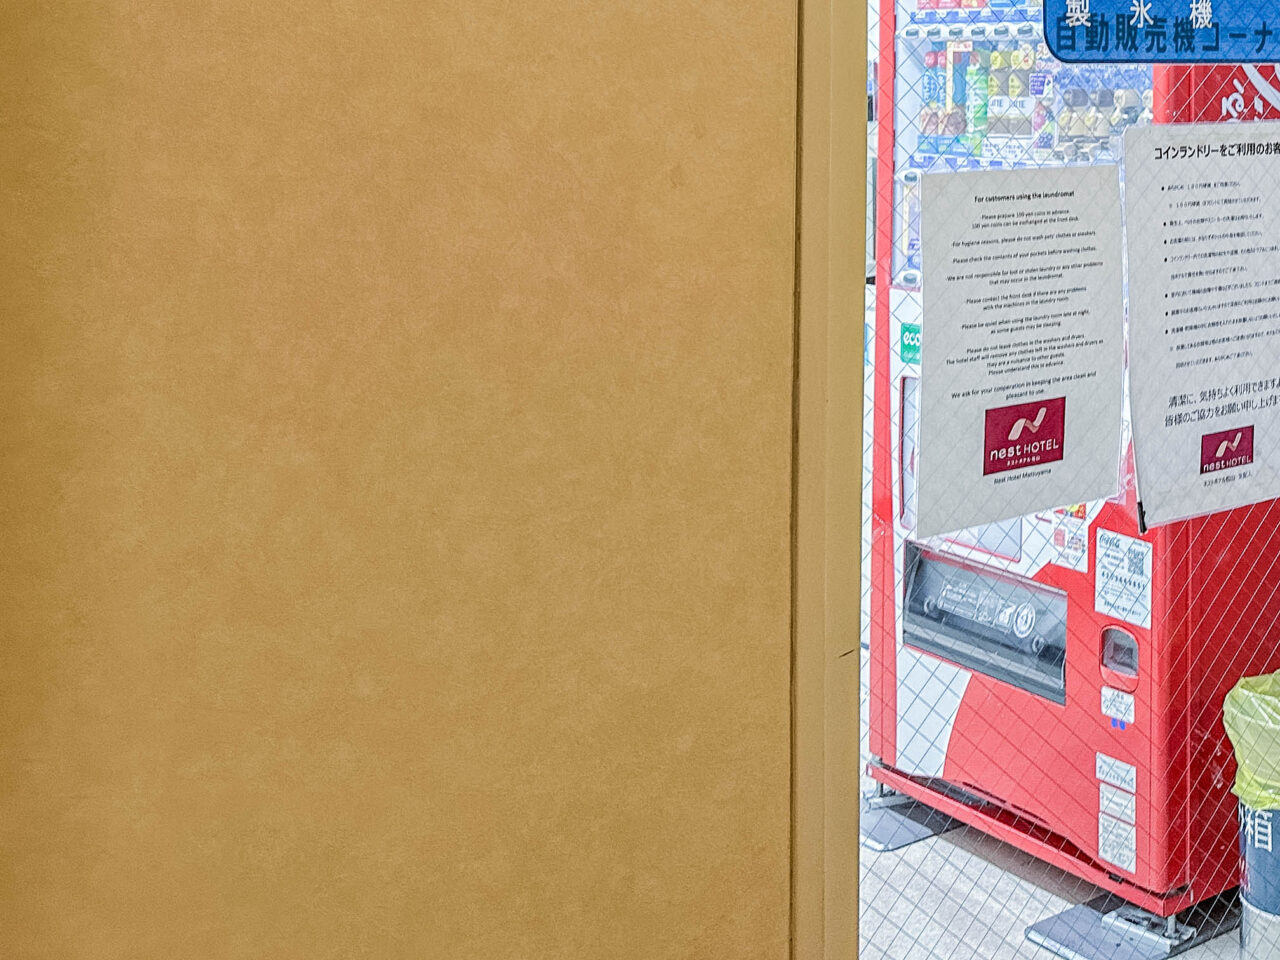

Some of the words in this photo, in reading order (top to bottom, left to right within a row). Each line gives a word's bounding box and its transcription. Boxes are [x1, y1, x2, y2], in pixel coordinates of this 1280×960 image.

[985, 193, 1015, 202] customers
[1016, 193, 1031, 202] using
[1042, 190, 1075, 199] laundromat
[990, 445, 1021, 461] nest
[1023, 438, 1059, 454] HOTEL
[1203, 460, 1226, 472] nest
[1226, 455, 1251, 467] HOTEL
